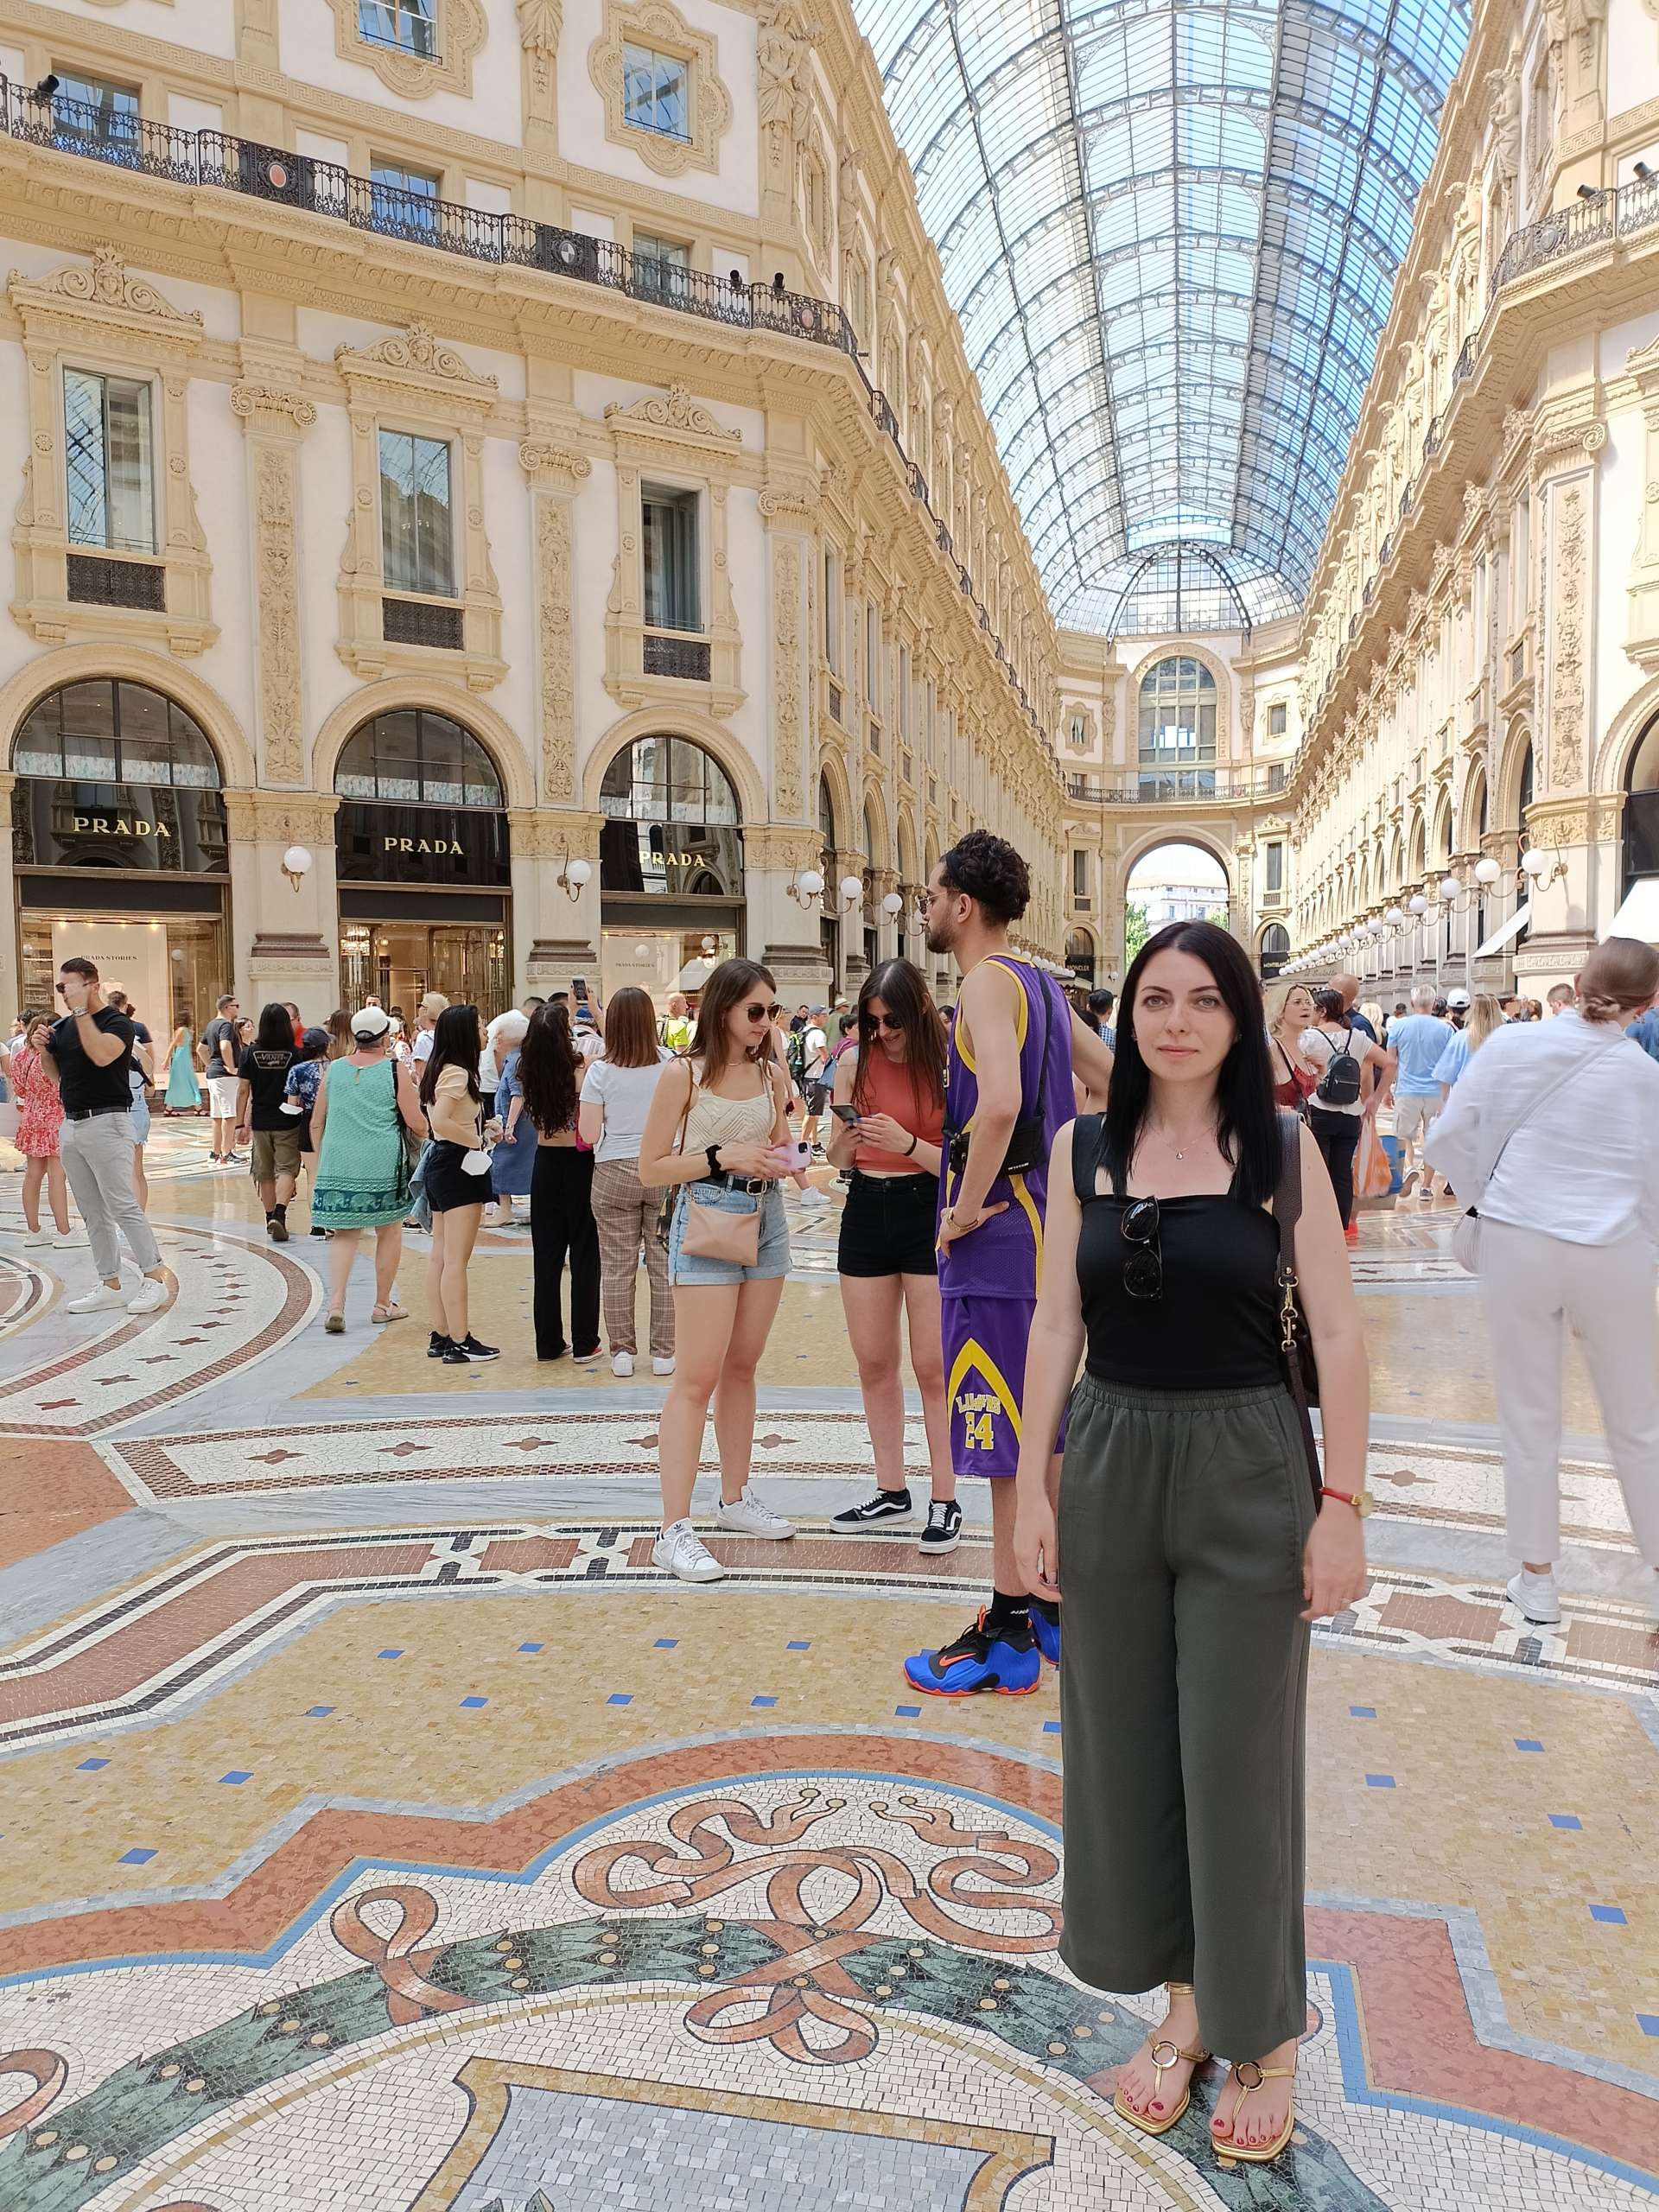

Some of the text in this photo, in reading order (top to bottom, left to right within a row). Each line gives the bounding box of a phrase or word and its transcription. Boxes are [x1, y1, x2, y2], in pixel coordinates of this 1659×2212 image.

[73, 817, 171, 836] PRADA
[384, 836, 464, 855] PRADA
[638, 849, 706, 867] PRADA
[964, 1411, 995, 1450] 24
